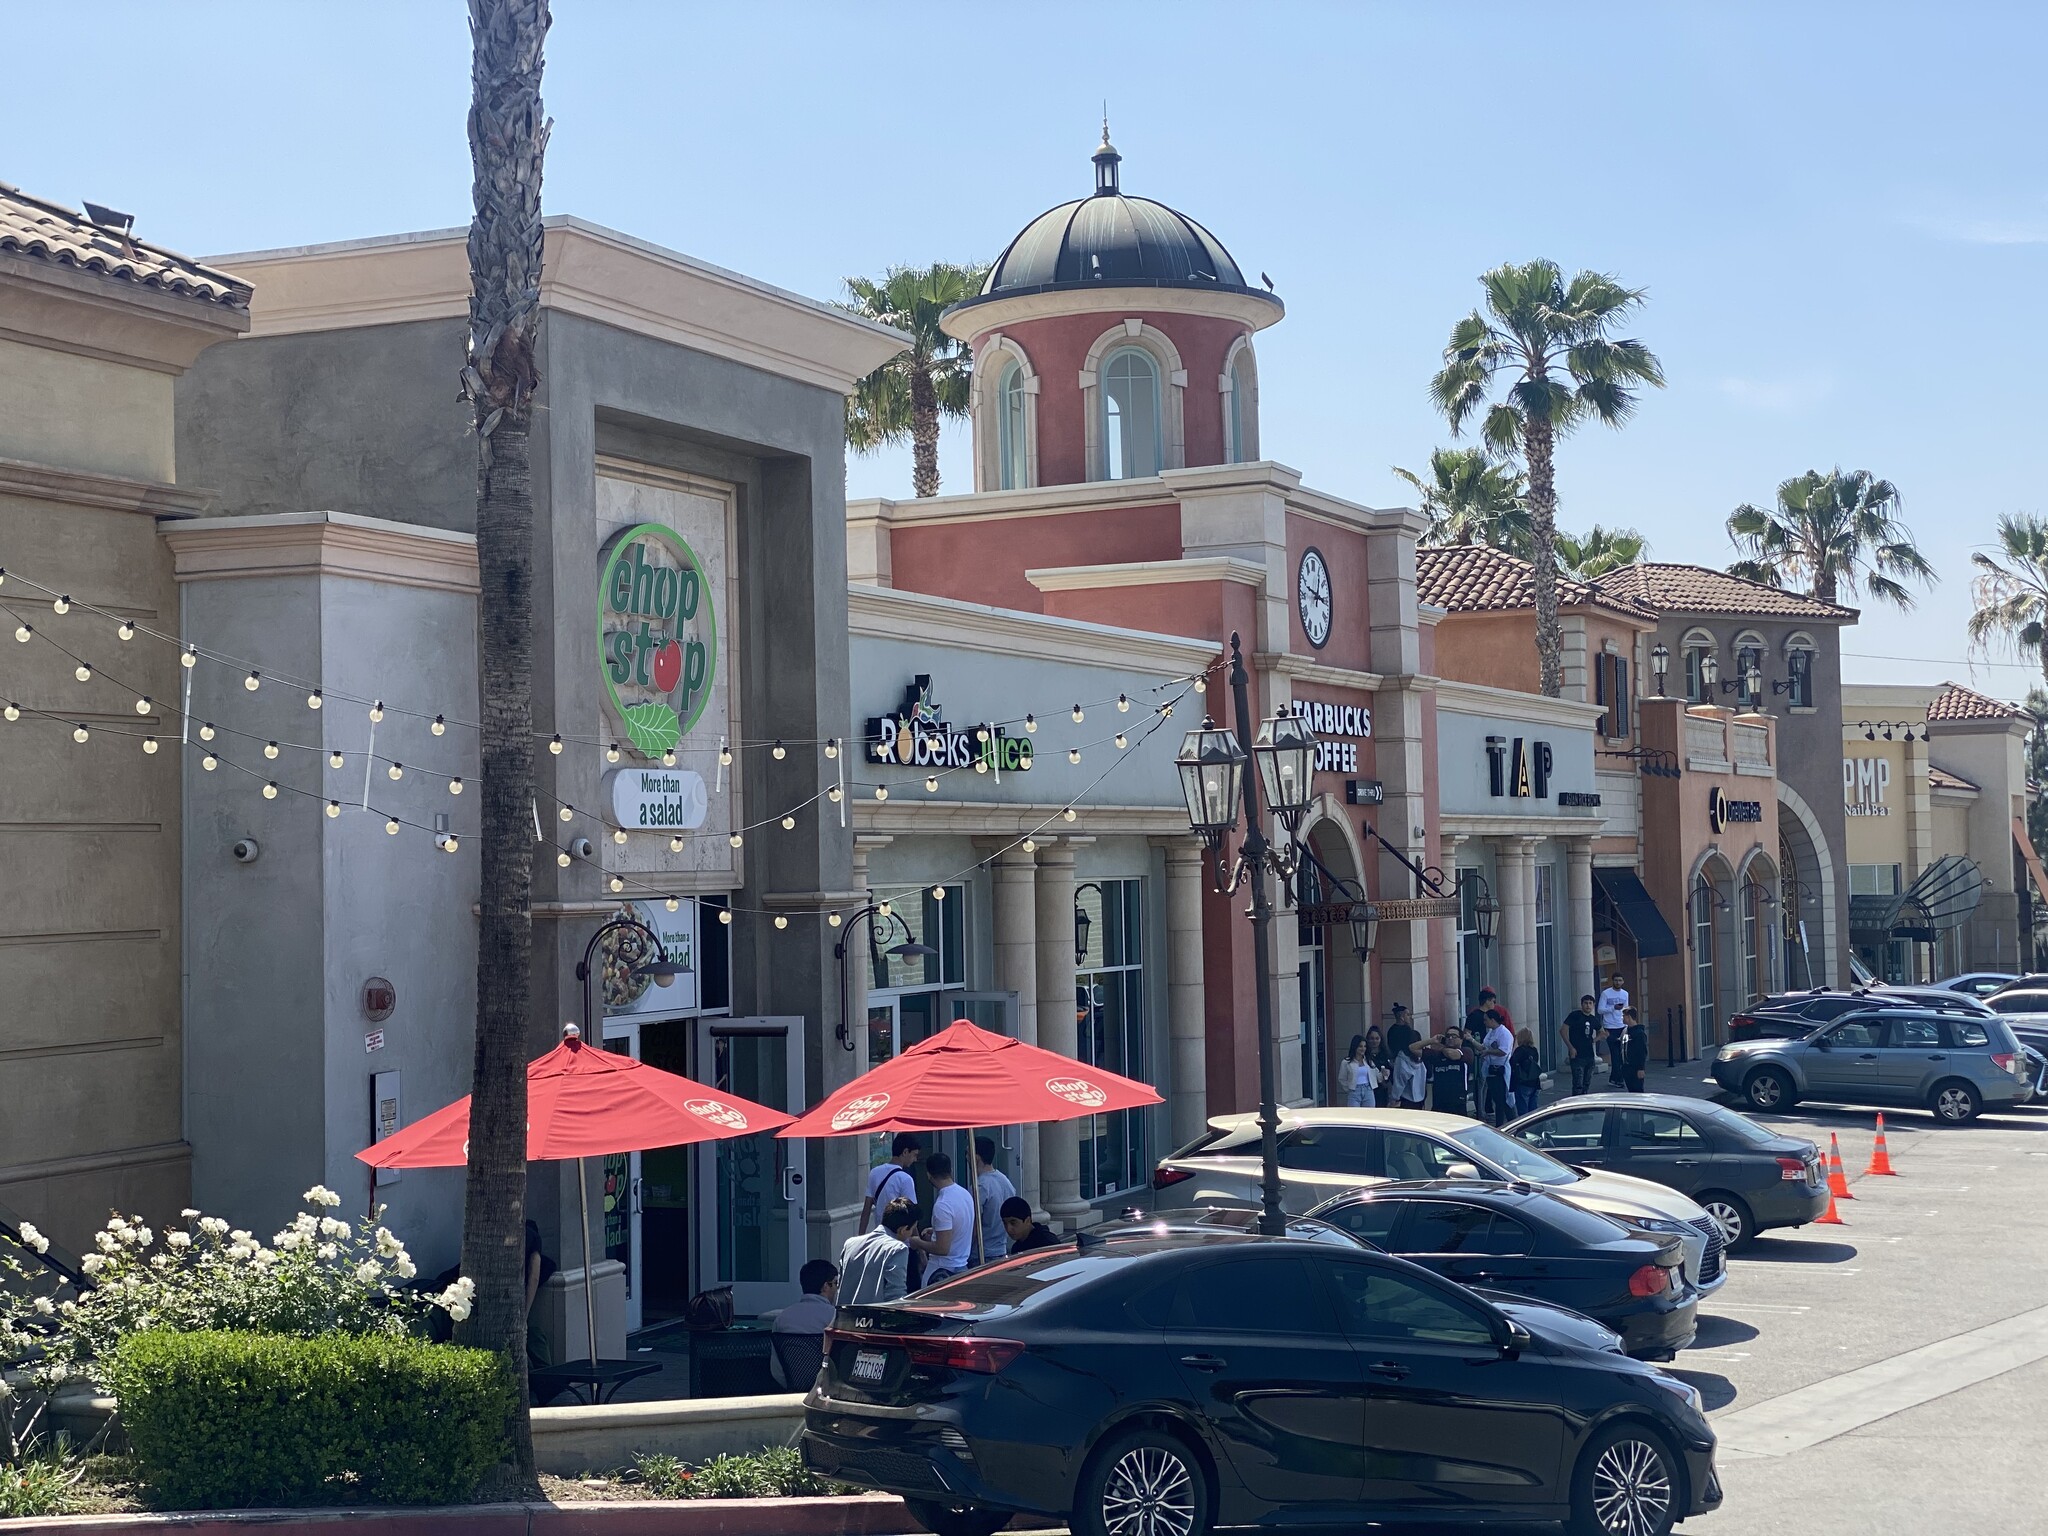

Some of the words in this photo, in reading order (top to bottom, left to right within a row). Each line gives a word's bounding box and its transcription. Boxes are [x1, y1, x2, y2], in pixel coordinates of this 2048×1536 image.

[610, 543, 700, 640] chop
[611, 622, 706, 711] stop
[1292, 700, 1371, 737] TARBUCKS
[881, 718, 971, 768] Robeks
[974, 726, 1034, 771] Juice
[1314, 741, 1358, 773] OFFEE
[1486, 736, 1553, 798] TAP
[1843, 758, 1890, 803] PMP
[641, 773, 661, 794] More
[662, 775, 681, 794] than
[640, 803, 648, 825] a
[649, 795, 683, 827] salad
[1845, 804, 1864, 817] Nail
[1872, 804, 1892, 816] Bar
[663, 932, 675, 944] More
[674, 931, 685, 943] than
[685, 933, 690, 942] a
[1050, 1081, 1089, 1092] chop
[1064, 1090, 1103, 1102] stop
[849, 1096, 889, 1112] chop
[855, 1317, 874, 1328] KIA
